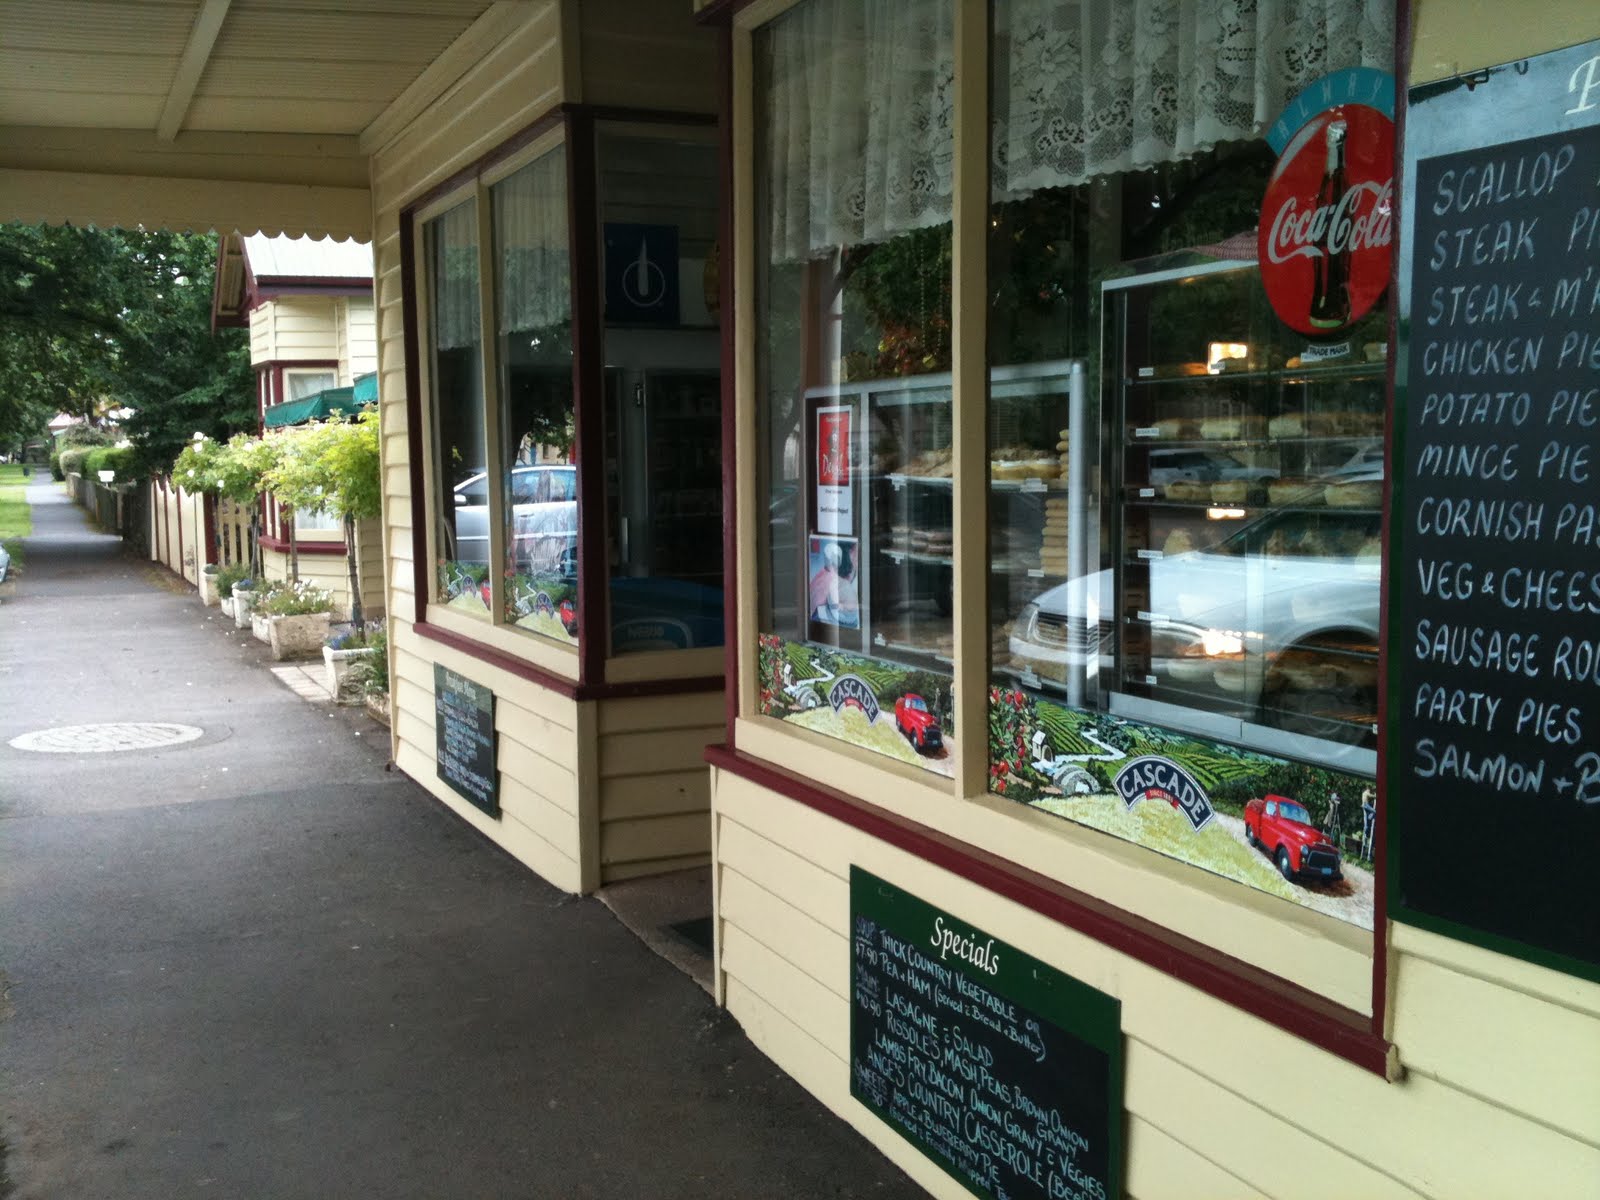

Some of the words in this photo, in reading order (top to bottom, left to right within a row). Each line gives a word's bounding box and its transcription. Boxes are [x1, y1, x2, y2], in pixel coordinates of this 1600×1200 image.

[1277, 72, 1395, 139] ALWAY
[1432, 144, 1575, 217] SCALLOP
[1268, 177, 1394, 264] Coca-Cola
[1430, 216, 1539, 272] STEAK
[1567, 207, 1600, 252] PI
[1427, 282, 1522, 327] STEAK
[1423, 335, 1544, 376] CHICKEN
[1420, 391, 1531, 426] POTATO
[1546, 389, 1598, 428] PIE
[1416, 443, 1520, 481] MINCE
[1537, 440, 1591, 484] PIE
[1416, 497, 1544, 542] CORNISH
[1416, 557, 1473, 600] VEG
[1482, 570, 1494, 595] &
[1415, 618, 1540, 677] SAUSAGE
[832, 680, 877, 718] CASCADE
[1414, 681, 1502, 732] PARTY
[1516, 698, 1582, 745] PIES
[1120, 763, 1205, 822] CASCADE
[1413, 737, 1546, 795] SALMON
[930, 917, 999, 976] Specials
[879, 952, 900, 980] PEA
[907, 968, 932, 1001] HAM
[971, 1004, 1002, 1033] Bread
[880, 930, 907, 963] THICK
[907, 944, 952, 990] COUNTRY
[956, 972, 1018, 1024] VEGETABLE
[886, 986, 939, 1039] LASAGNE
[952, 1025, 994, 1067] SALAD
[908, 1046, 928, 1085] FRY
[1004, 1110, 1042, 1157] GRAVY
[908, 1072, 960, 1134] COUNTRY
[965, 1111, 1044, 1189] CASSEROLE
[1014, 1085, 1049, 1127] BROWN
[1050, 1108, 1089, 1152] ONION
[980, 1152, 1001, 1183] PIE
[1036, 1121, 1077, 1158] GRAVY
